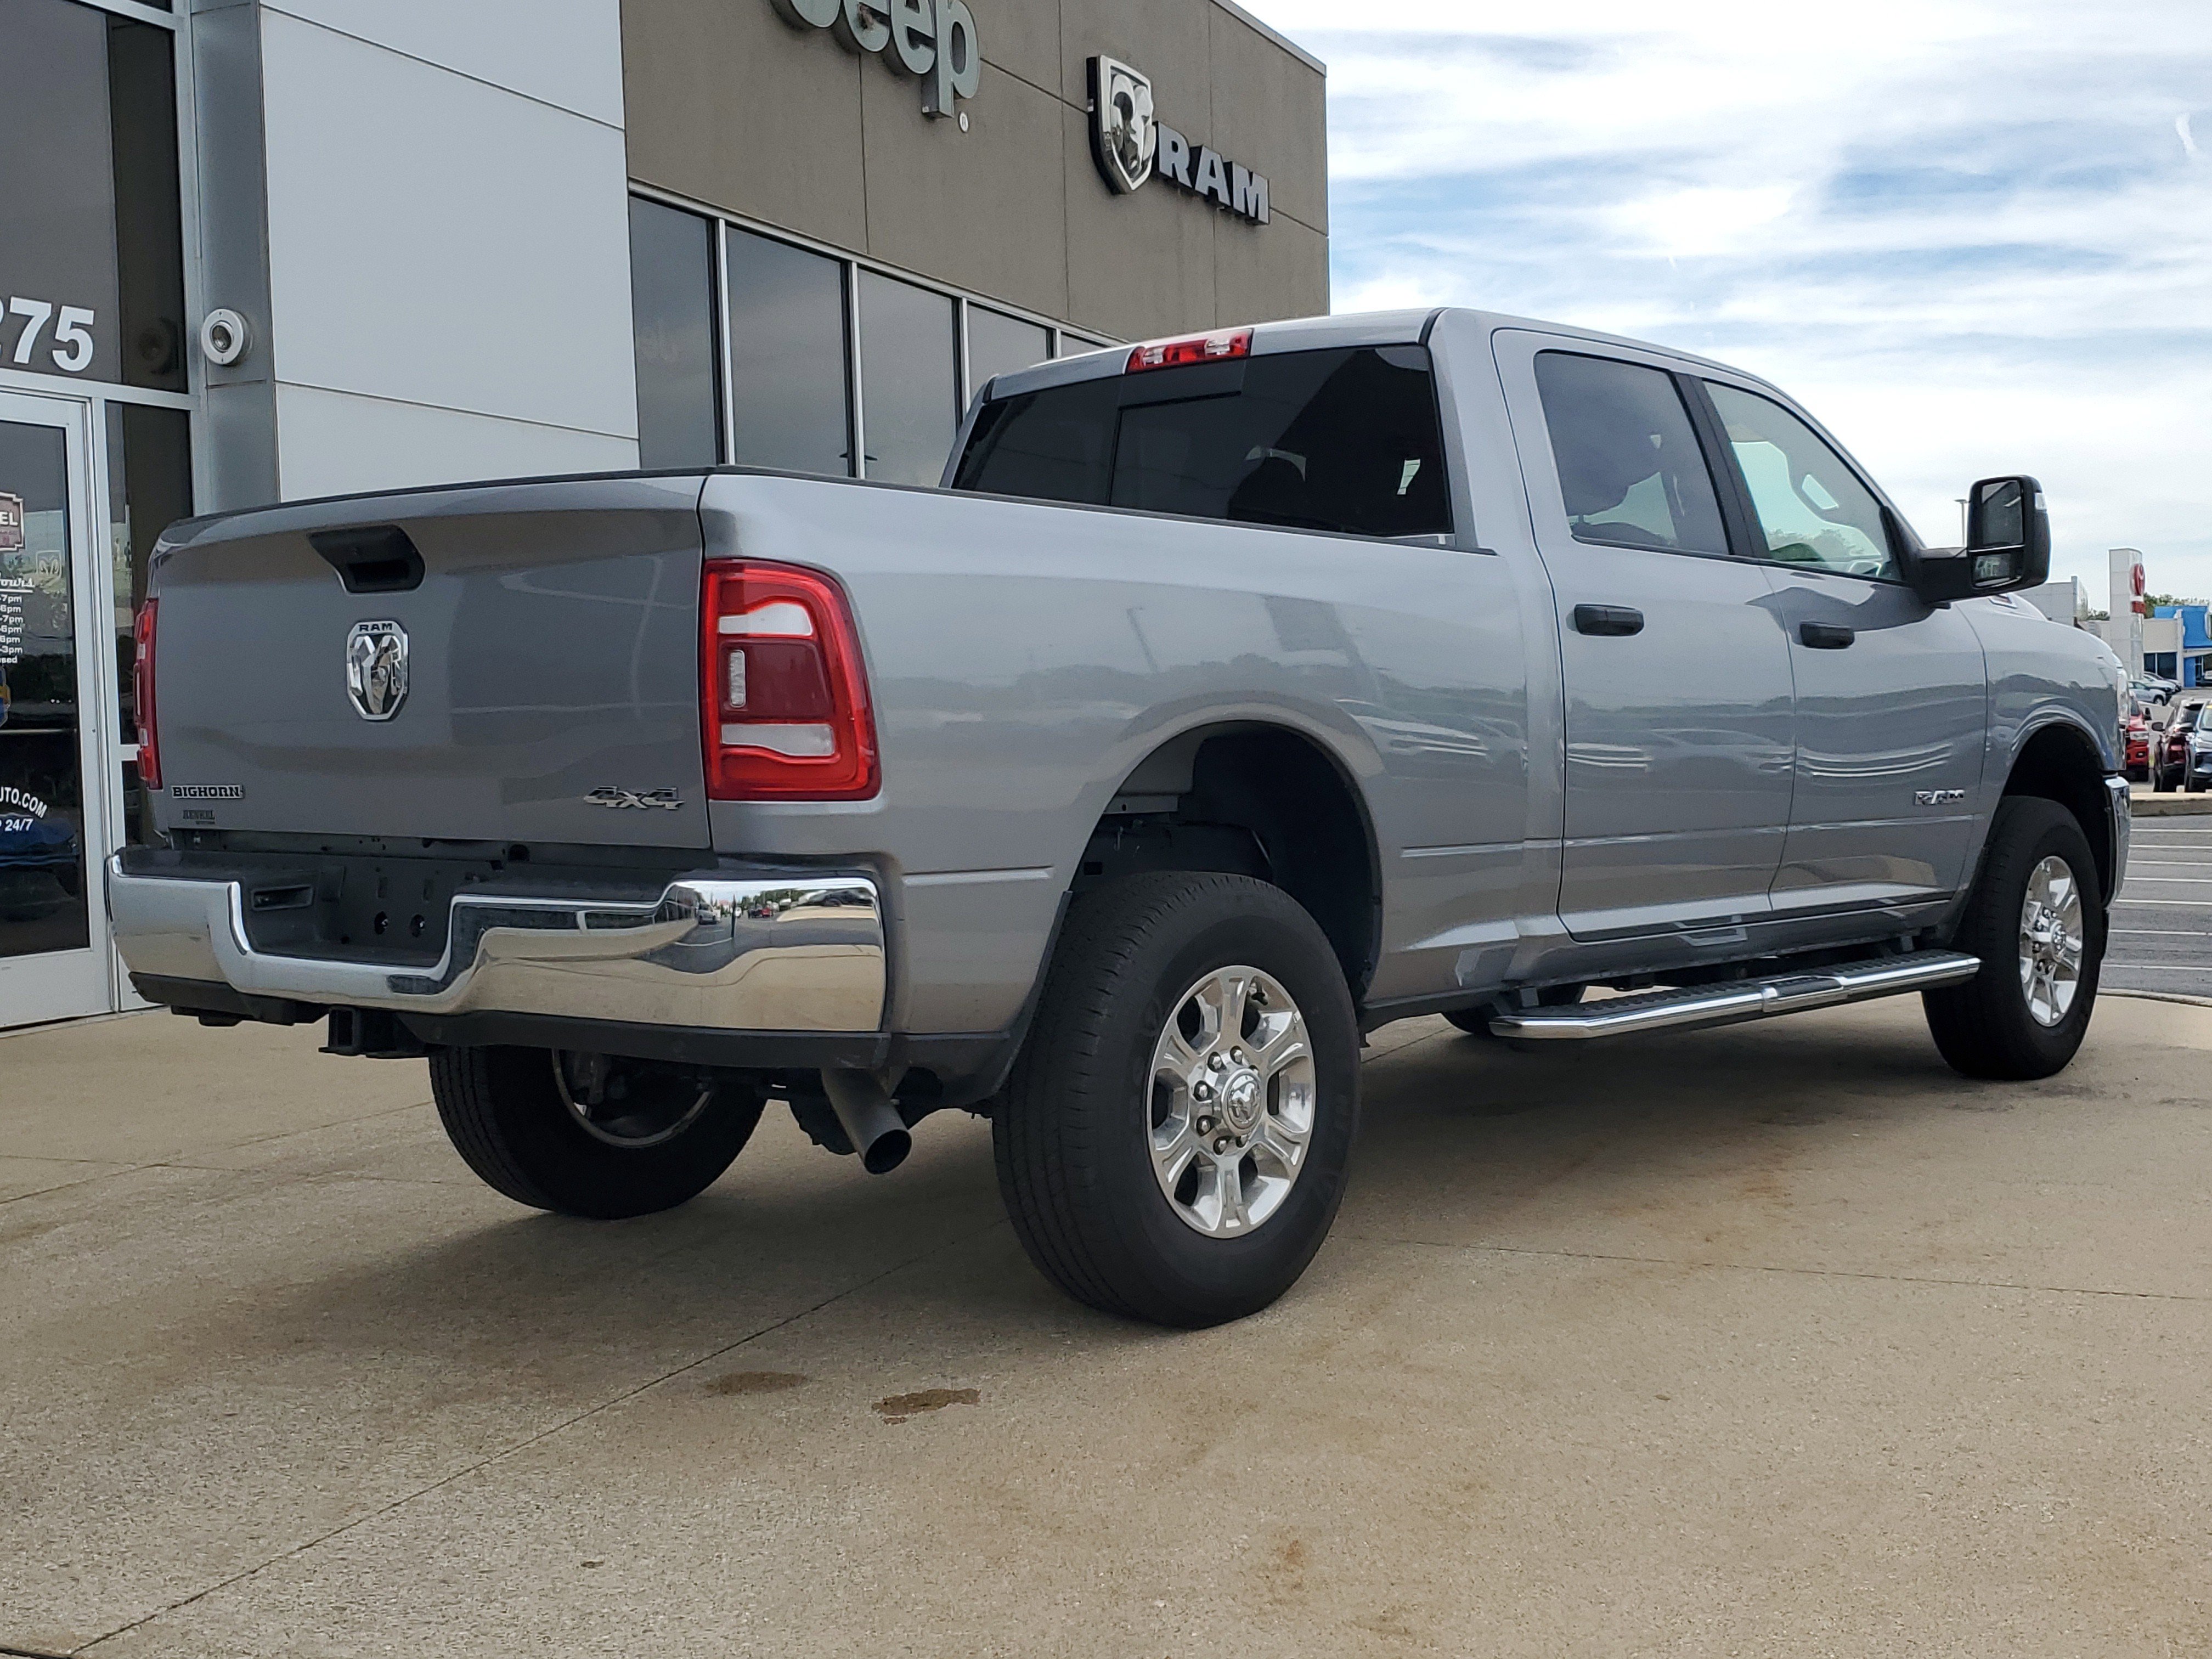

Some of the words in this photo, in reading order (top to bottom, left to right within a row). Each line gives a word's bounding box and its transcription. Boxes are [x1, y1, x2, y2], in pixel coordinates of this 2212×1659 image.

[791, 0, 980, 118] eep
[1158, 121, 1269, 224] RAM
[0, 296, 94, 372] 75
[359, 623, 392, 632] RAM
[1915, 789, 1965, 805] RAM
[5, 818, 33, 832] 24/7
